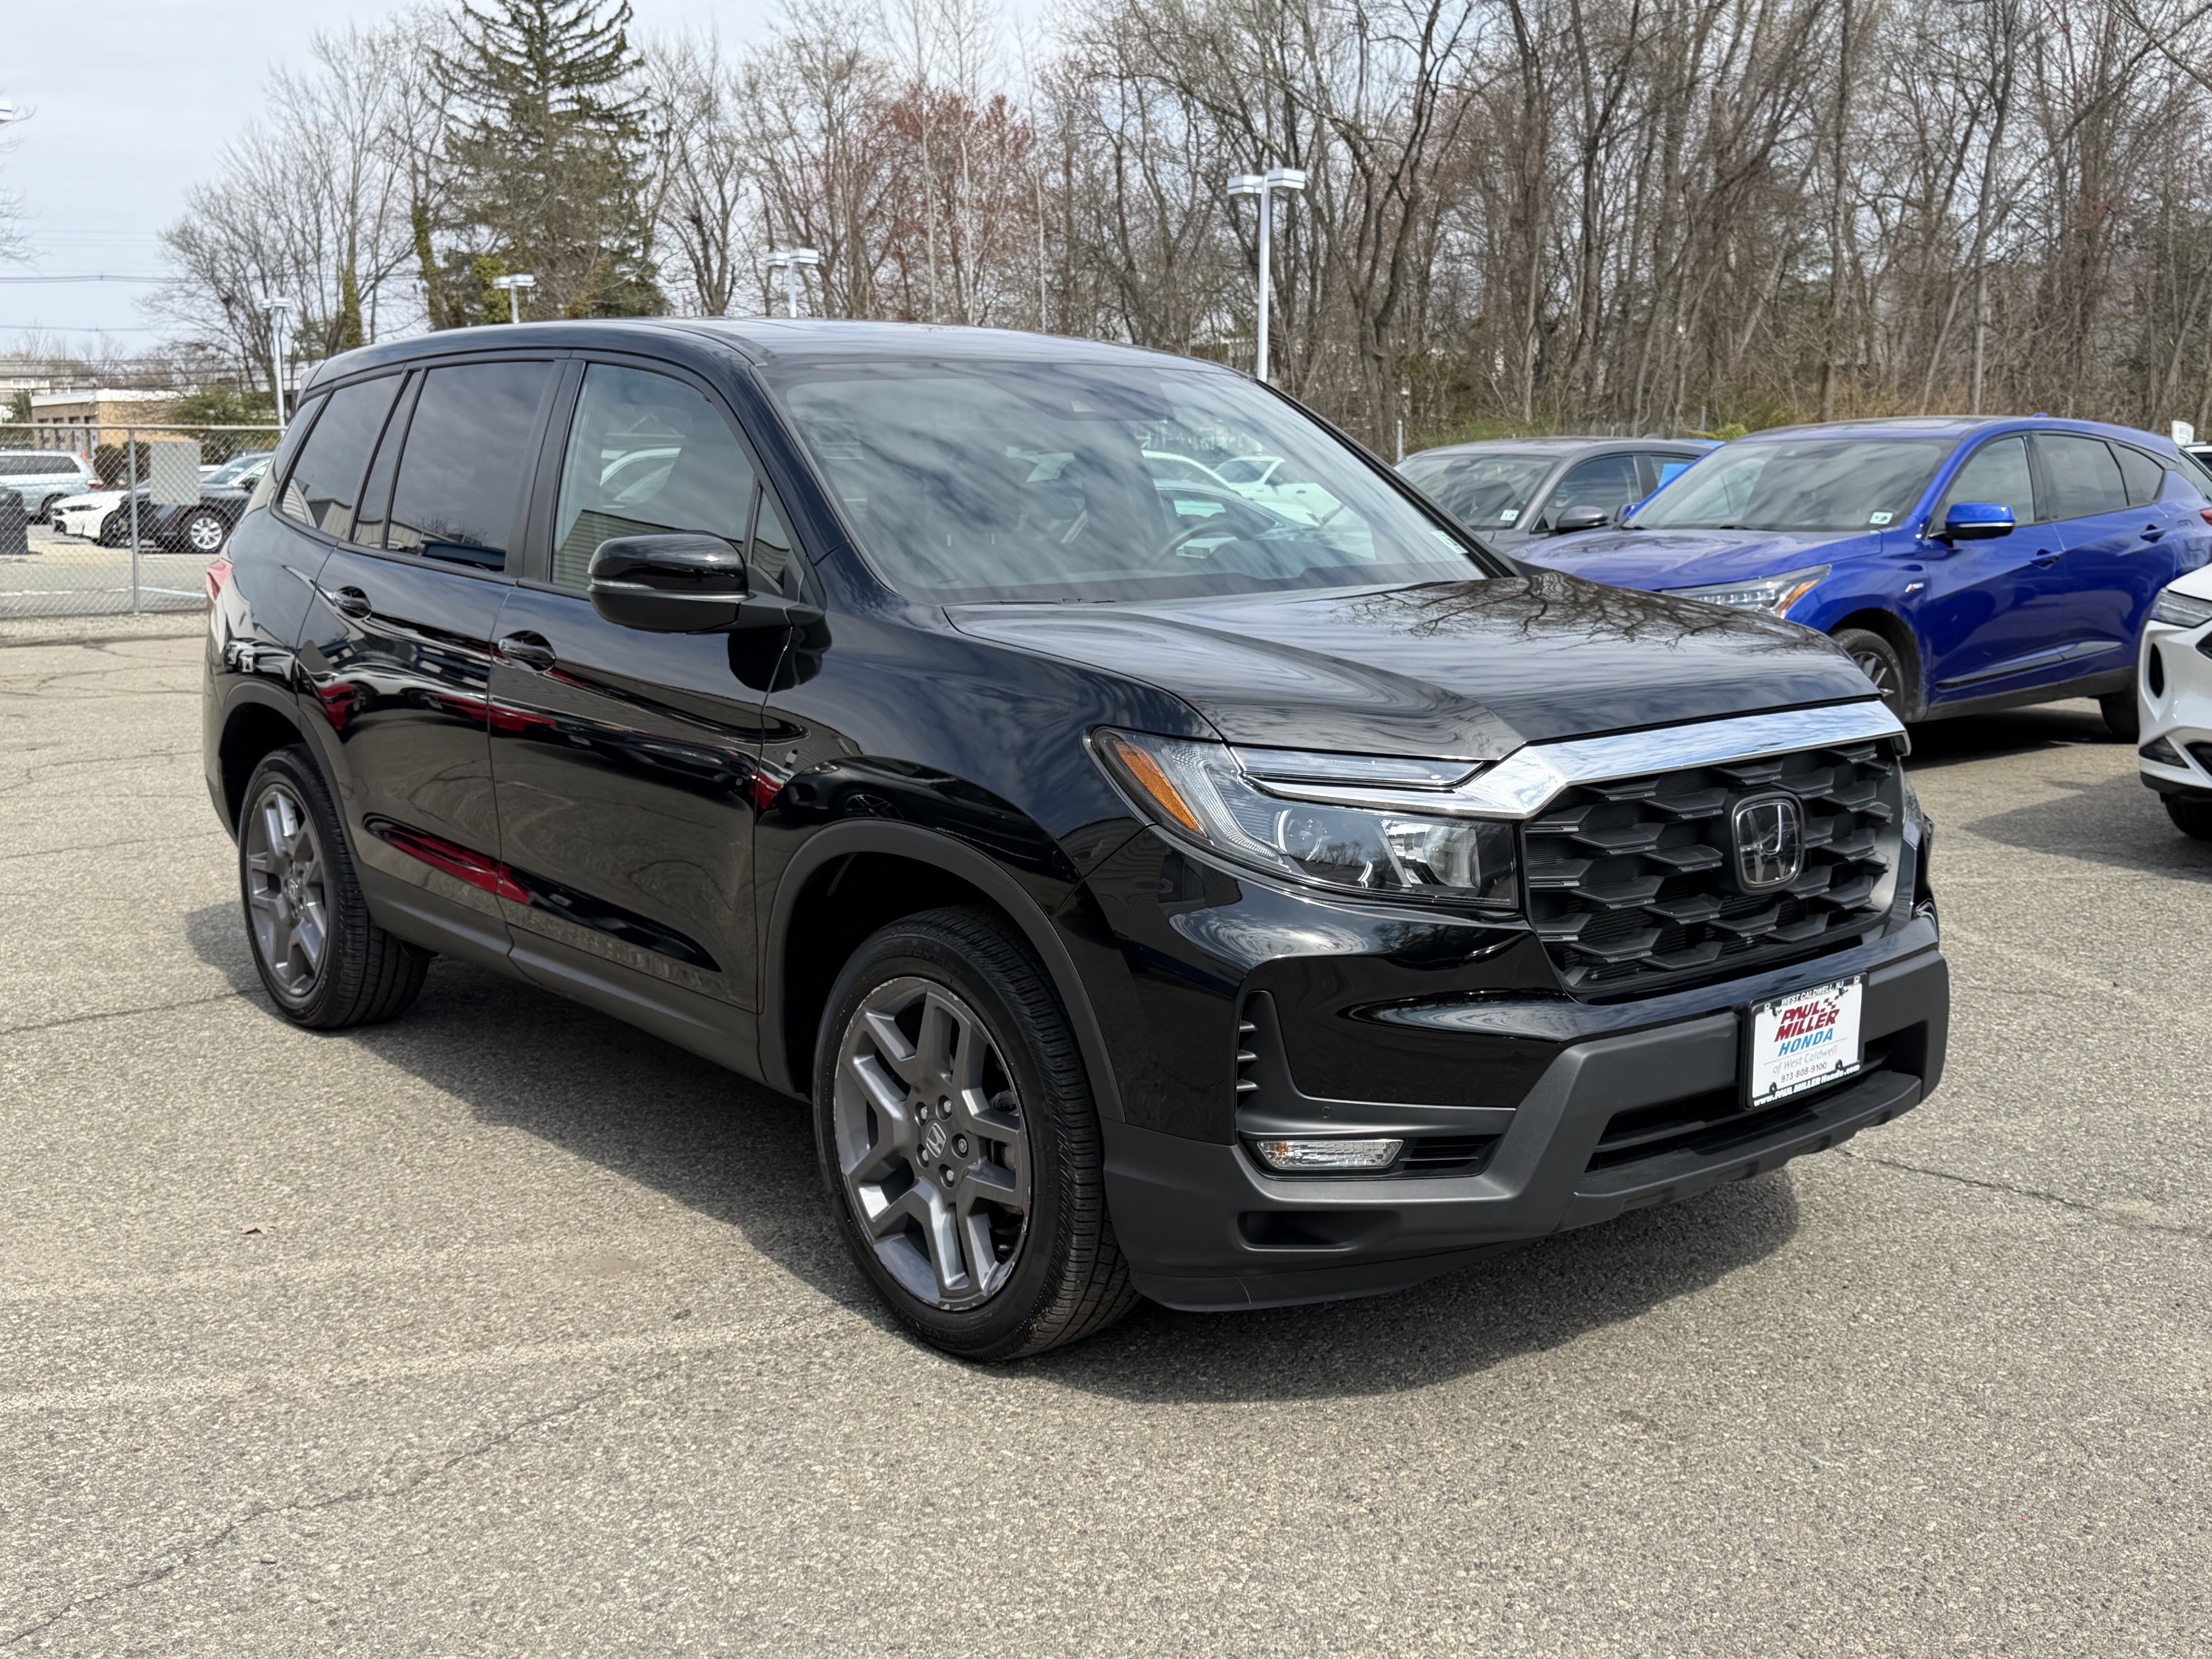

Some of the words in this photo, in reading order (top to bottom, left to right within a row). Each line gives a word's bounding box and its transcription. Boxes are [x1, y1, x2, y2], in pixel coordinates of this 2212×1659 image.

[1781, 994, 1800, 1006] WEST
[1836, 981, 1844, 990] NJ
[1774, 1008, 1840, 1042] MILLER
[1780, 1001, 1820, 1025] PAUL
[1778, 1027, 1833, 1057] HONDA
[1773, 1062, 1782, 1074] of
[1784, 1056, 1803, 1070] West
[1804, 1044, 1837, 1063] Caldwell
[1781, 1061, 1827, 1083] 973-808-9100
